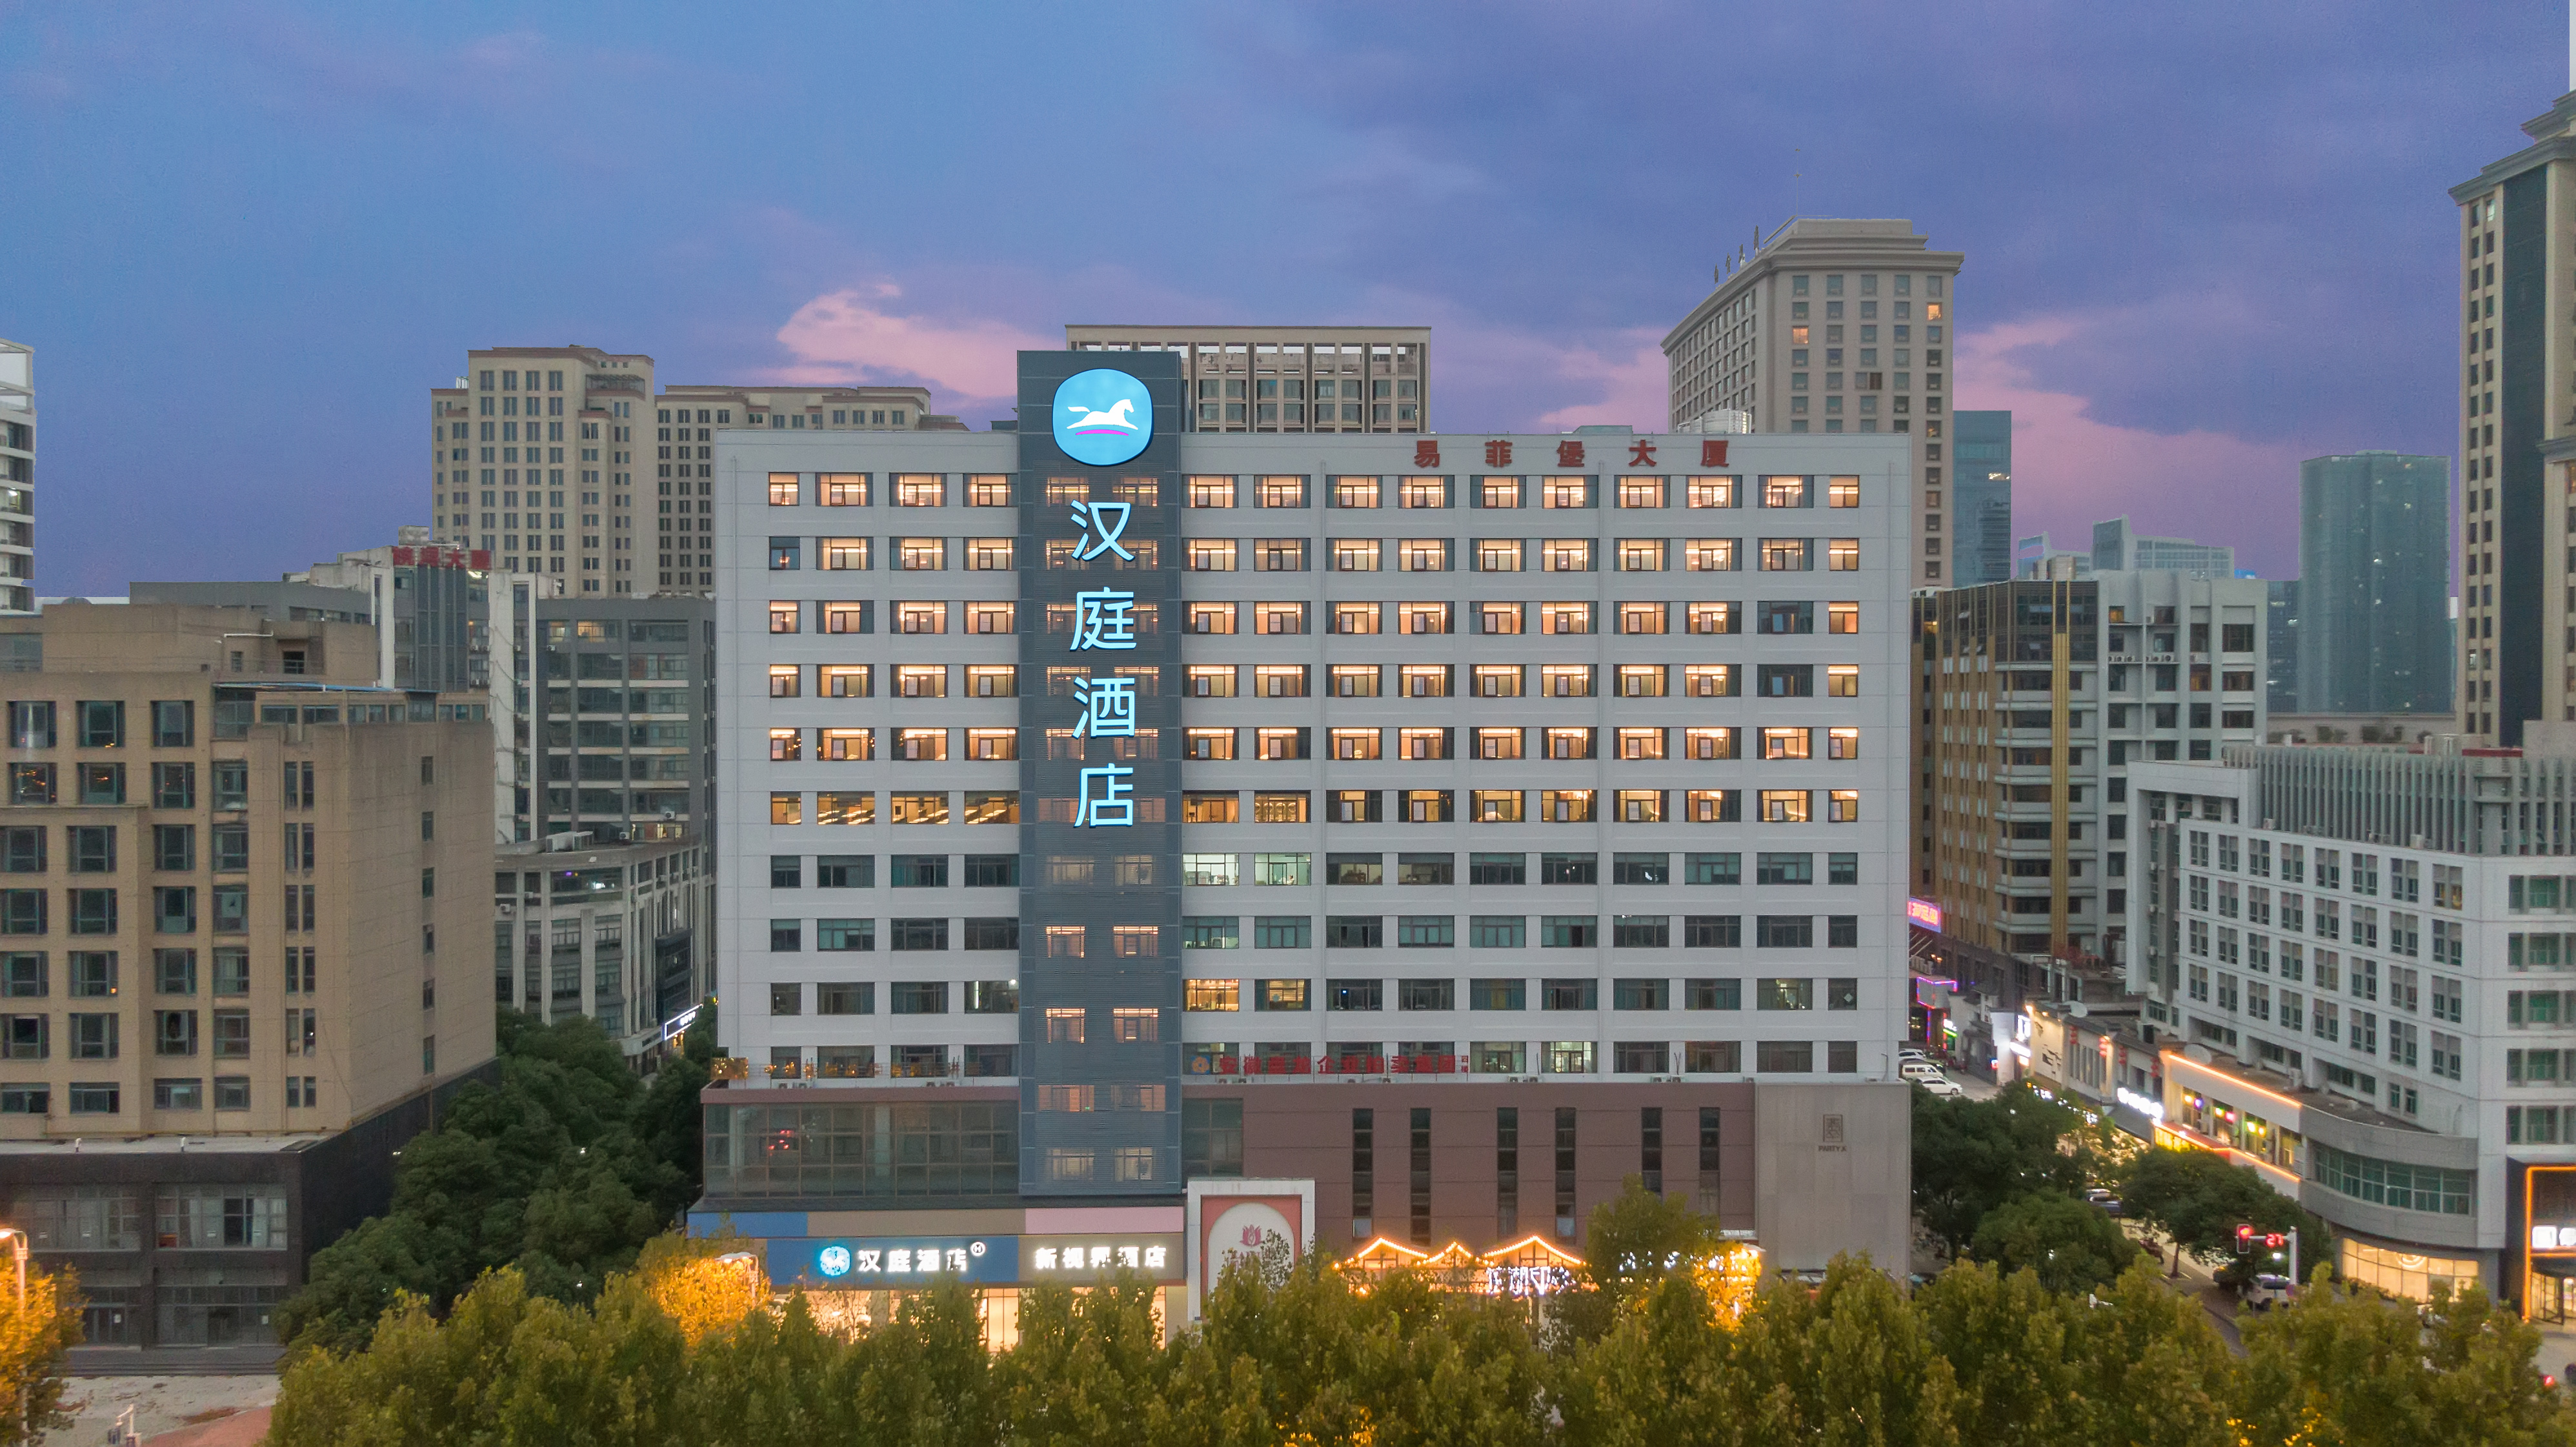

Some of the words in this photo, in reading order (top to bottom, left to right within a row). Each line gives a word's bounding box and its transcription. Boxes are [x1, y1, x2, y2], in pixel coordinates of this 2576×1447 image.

[1414, 440, 1729, 467] 易菲堡大厦
[1070, 499, 1136, 828] 汉庭酒店
[2266, 1233, 2283, 1247] 27
[858, 1248, 967, 1272] 汉庭酒店
[1035, 1246, 1166, 1269] 新视界酒店
